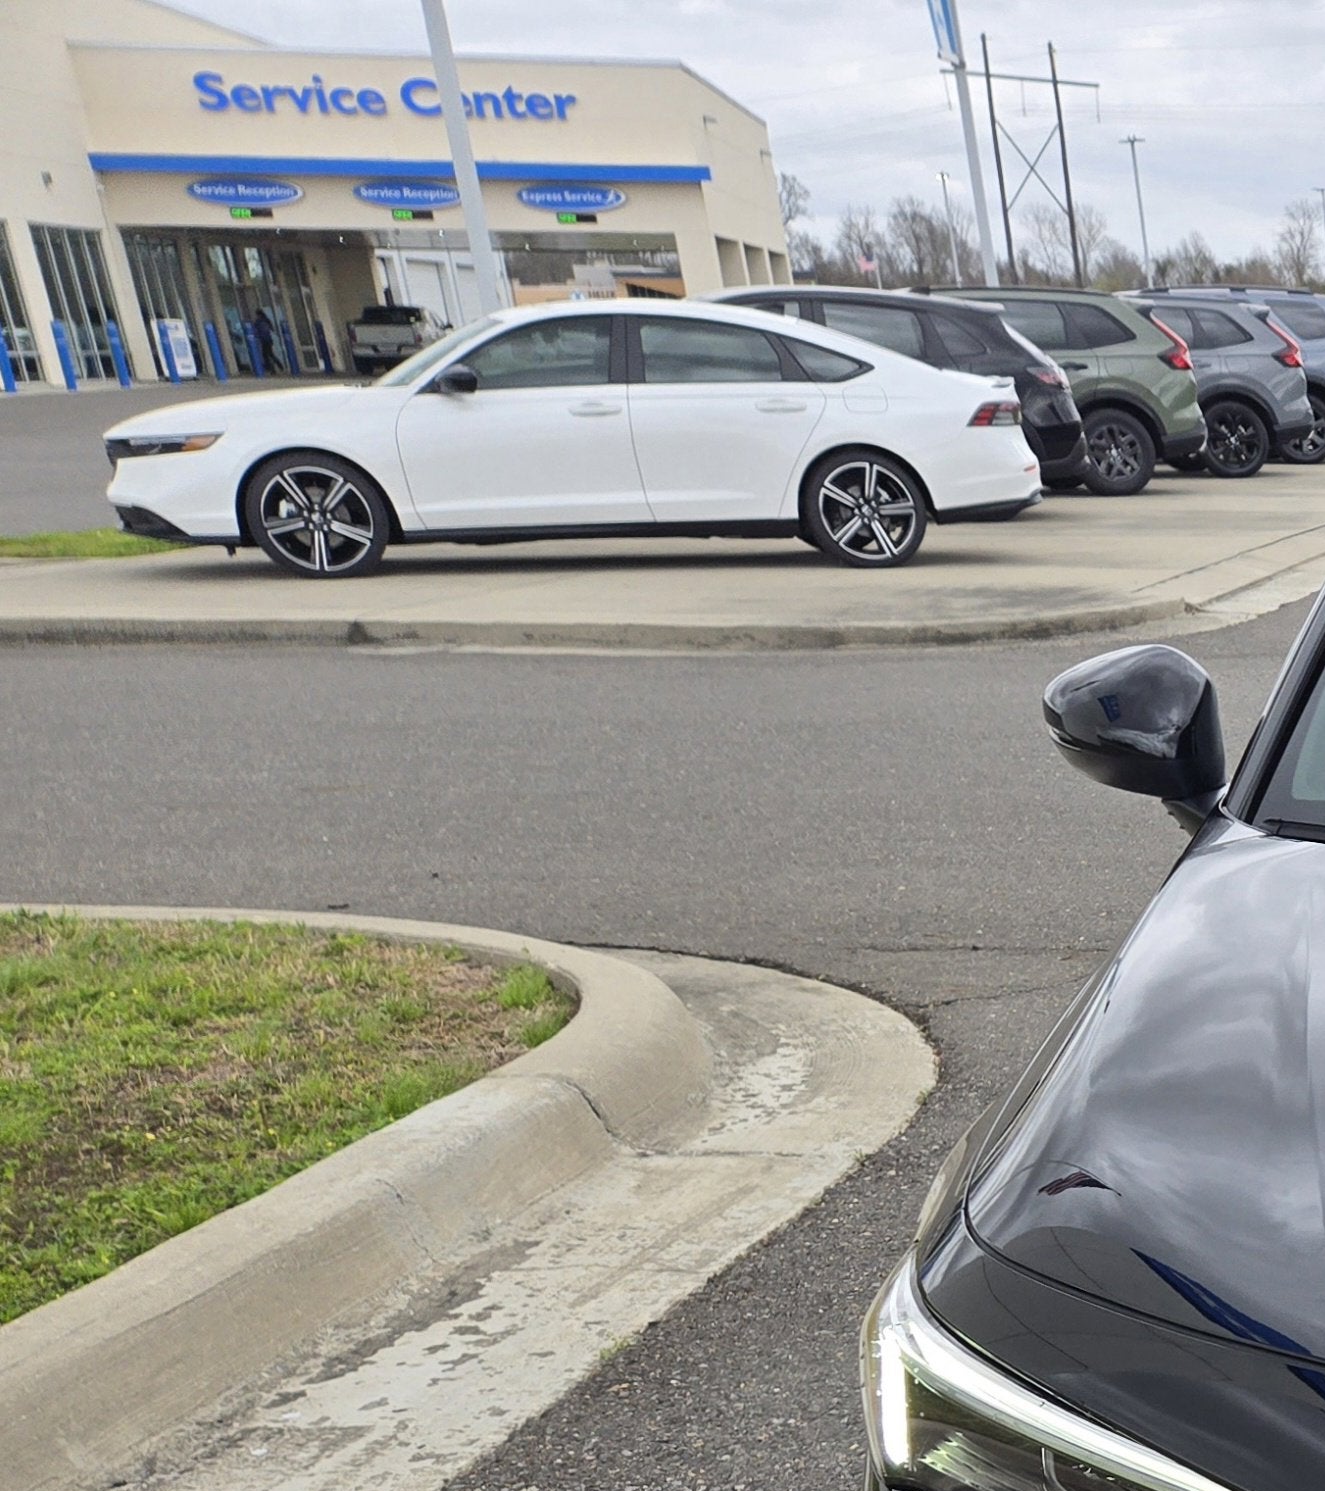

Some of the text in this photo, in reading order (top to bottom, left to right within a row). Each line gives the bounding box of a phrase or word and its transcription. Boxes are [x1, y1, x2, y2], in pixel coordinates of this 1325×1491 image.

[193, 71, 387, 116] Service
[193, 184, 295, 199] Service Reception
[360, 186, 401, 199] Service
